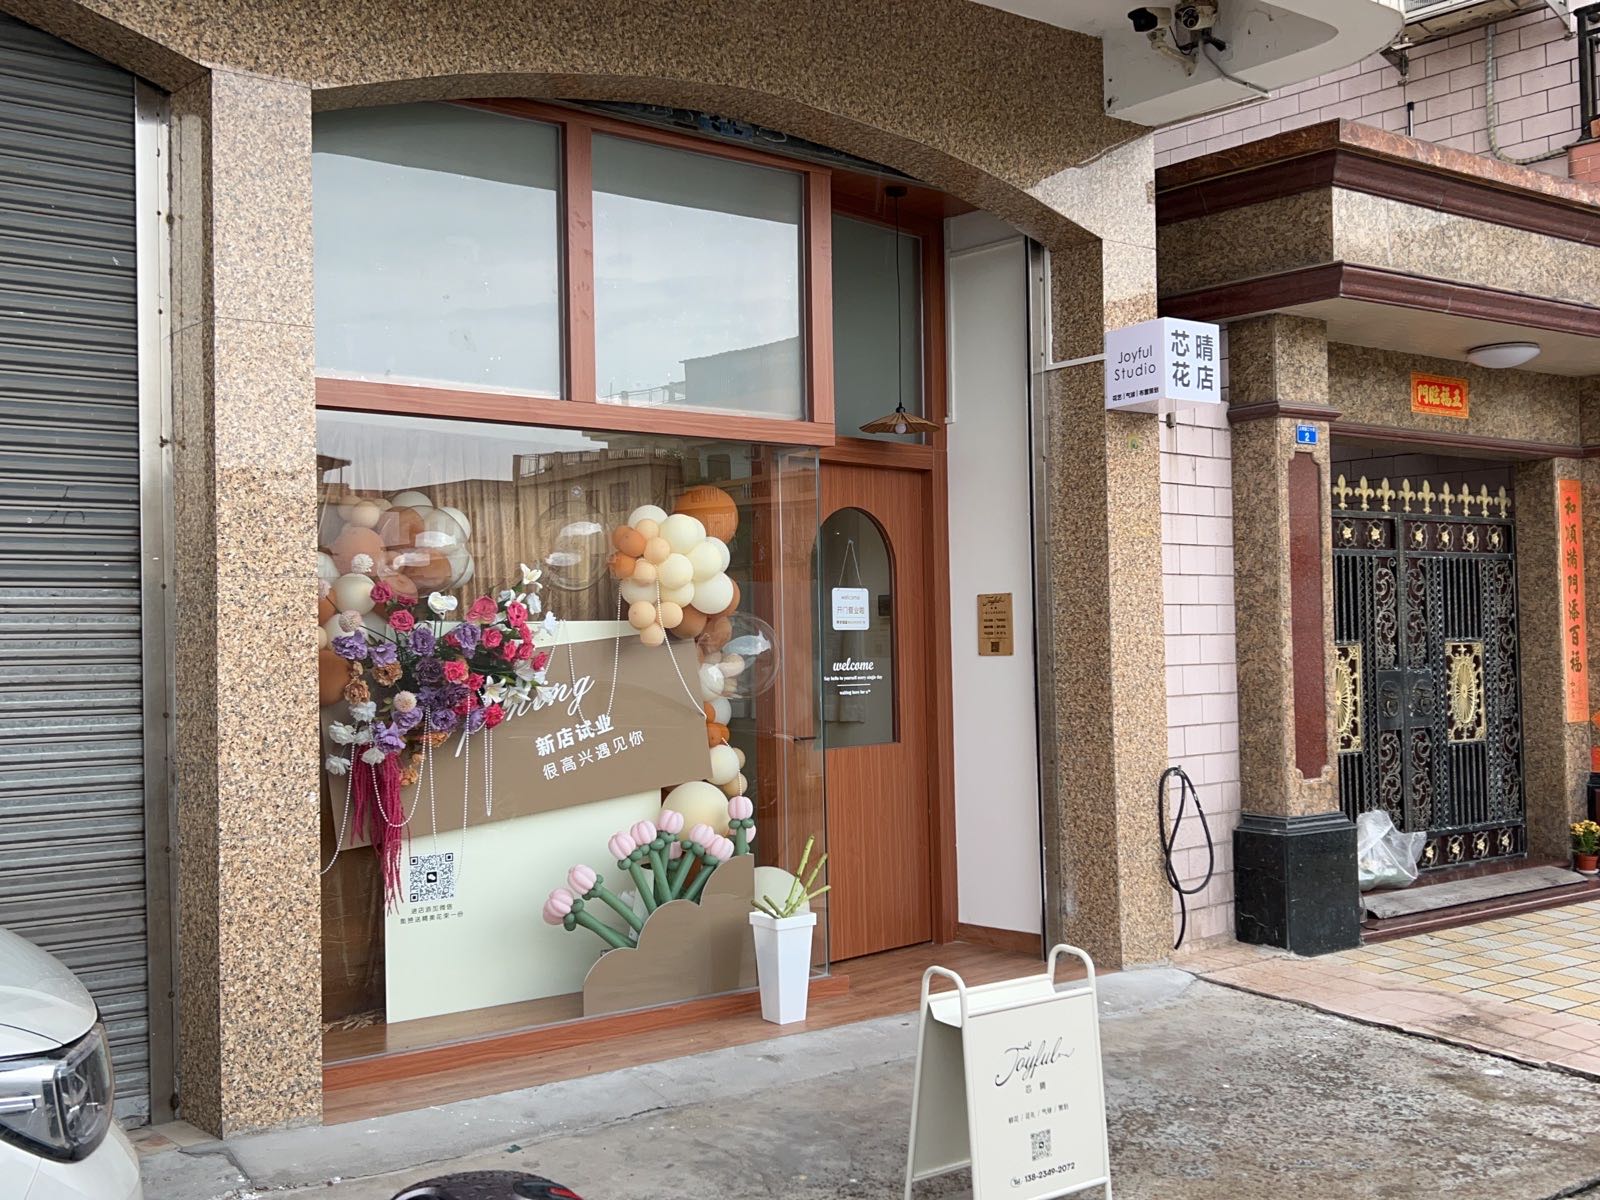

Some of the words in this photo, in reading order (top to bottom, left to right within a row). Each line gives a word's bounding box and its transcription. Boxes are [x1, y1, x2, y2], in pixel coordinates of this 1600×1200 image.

[1118, 344, 1153, 365] Joyful
[1171, 329, 1213, 362] 芯晴
[1114, 362, 1156, 382] Studio
[1172, 360, 1213, 392] 花店
[1304, 432, 1310, 442] 2
[832, 657, 874, 671] welcome
[535, 713, 615, 757] 新店试业
[542, 730, 645, 780] 很高兴遇见你
[995, 1036, 1076, 1087] Joyful
